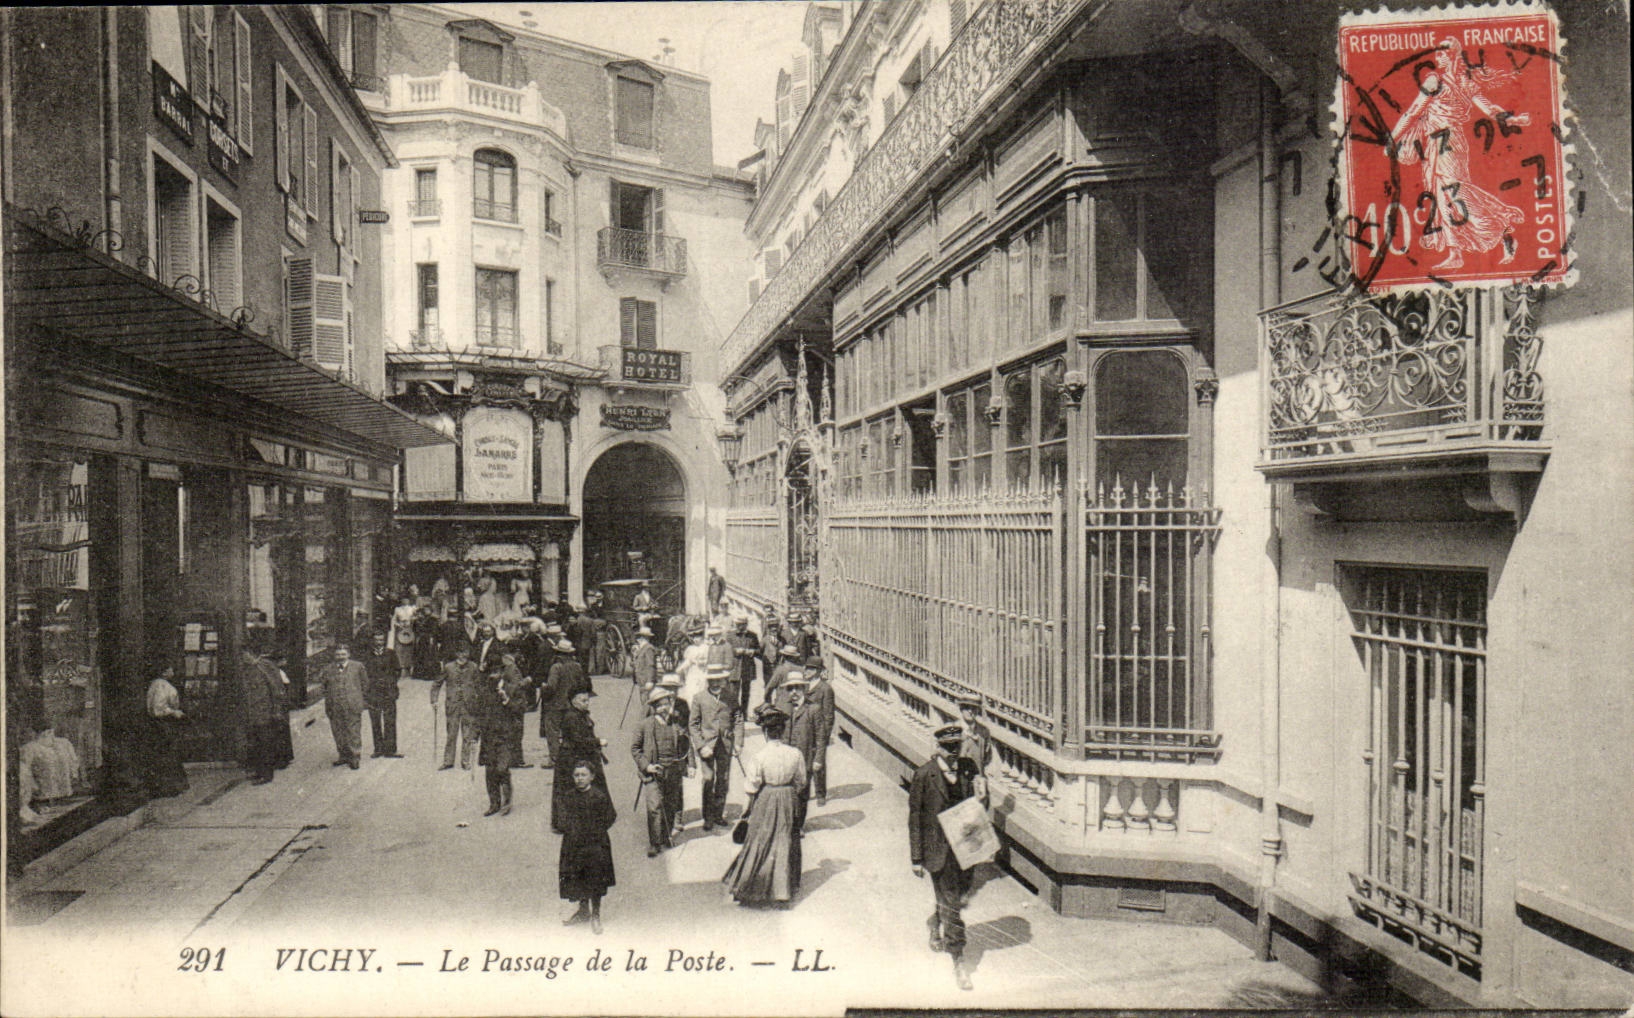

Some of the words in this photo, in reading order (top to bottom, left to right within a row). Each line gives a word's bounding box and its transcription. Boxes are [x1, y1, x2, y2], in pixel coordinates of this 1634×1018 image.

[1350, 31, 1436, 53] REPUBLIQUE
[627, 351, 677, 366] ROYAL
[624, 366, 679, 380] HOTEL
[606, 406, 637, 417] HENRI
